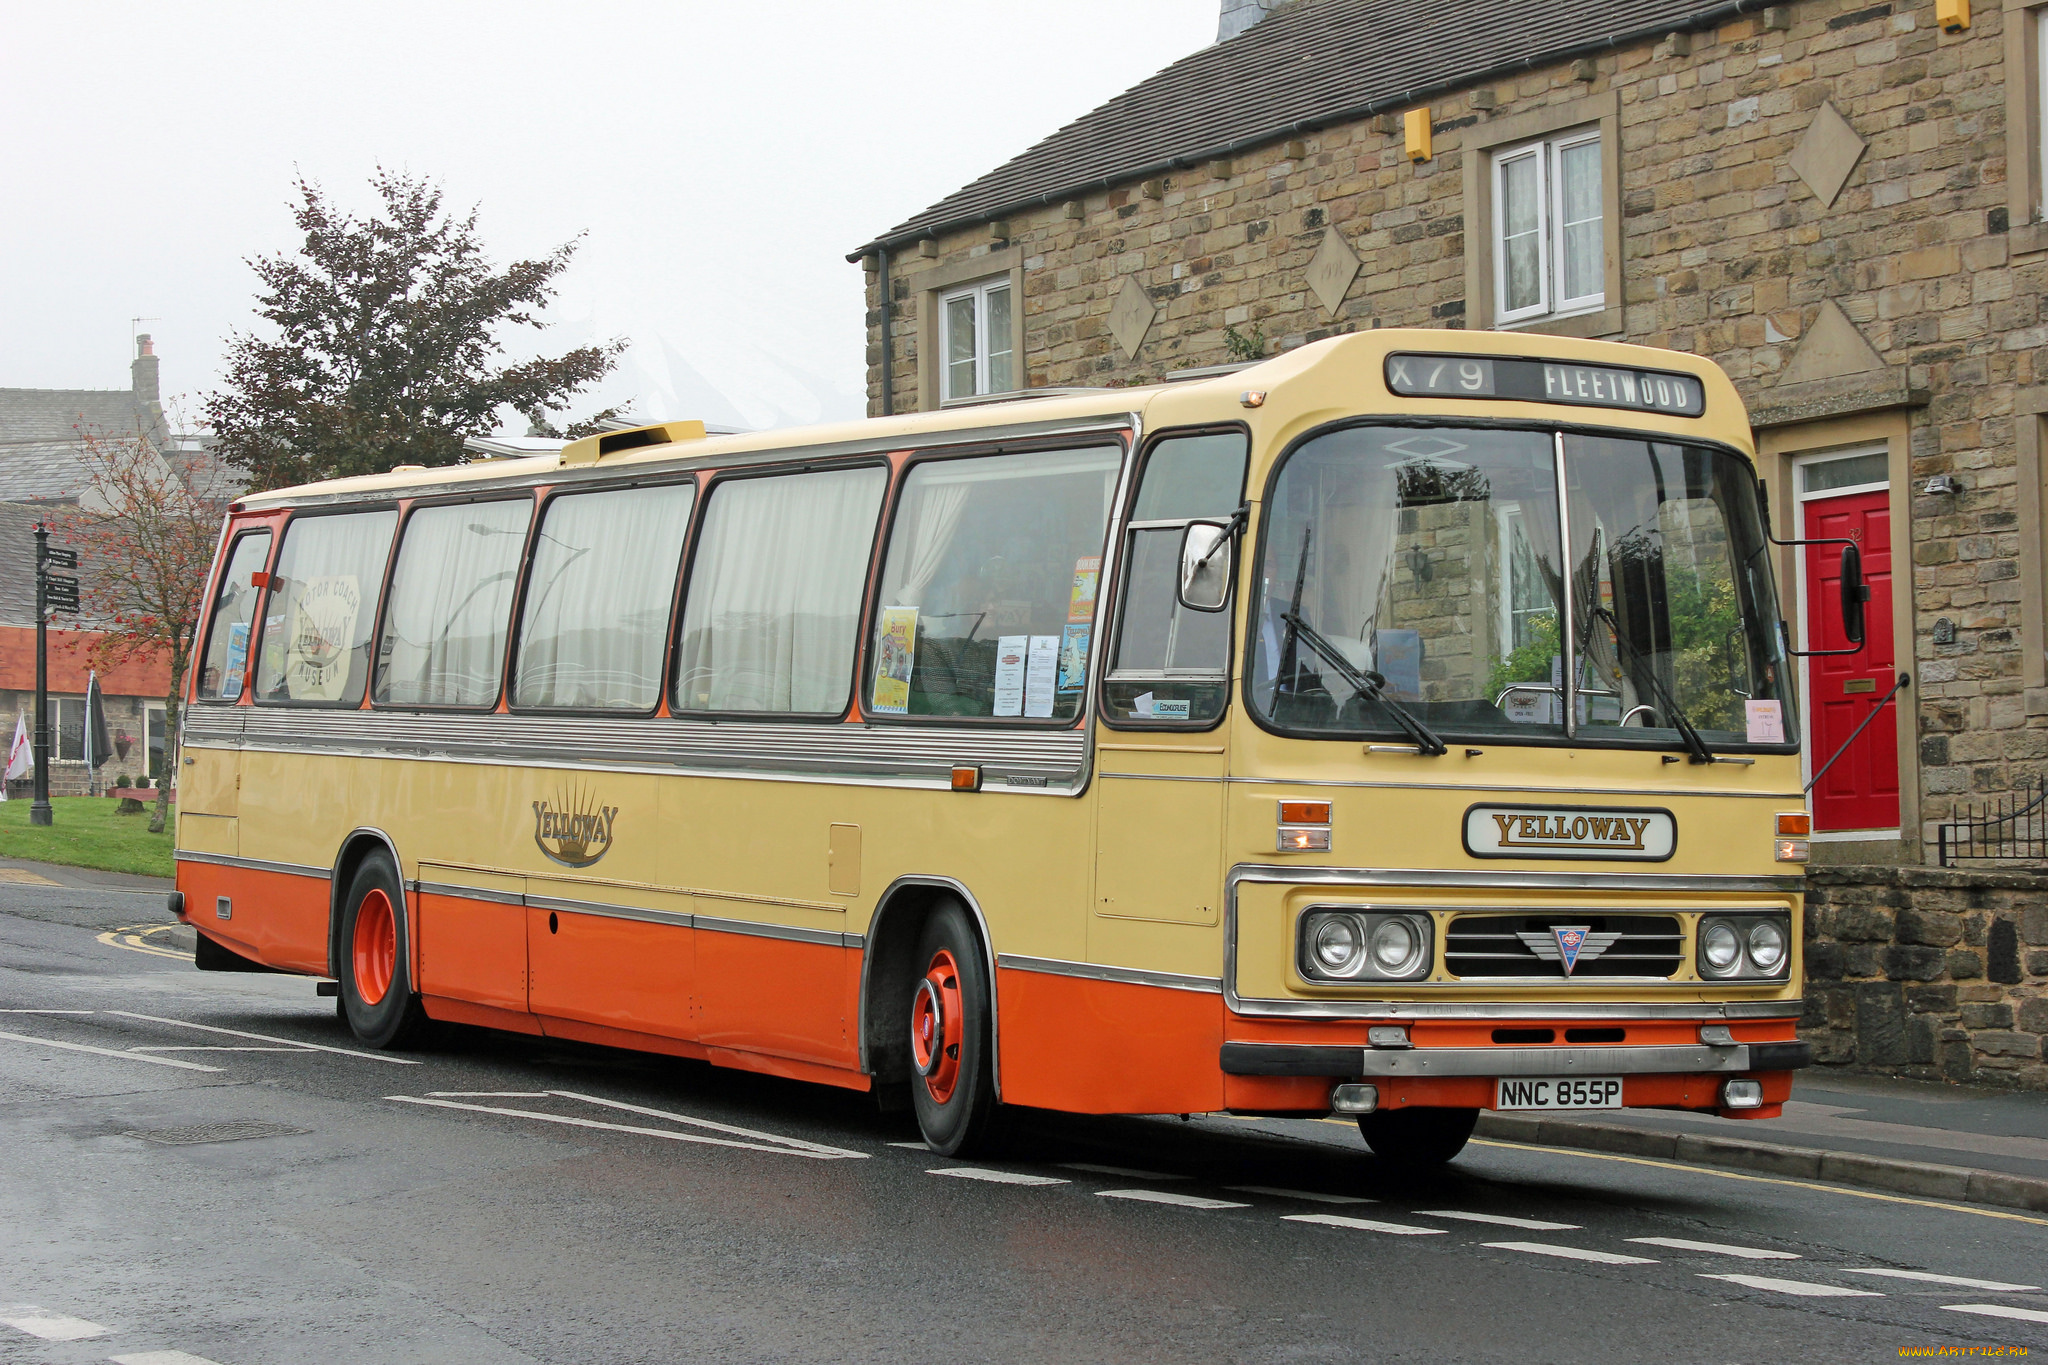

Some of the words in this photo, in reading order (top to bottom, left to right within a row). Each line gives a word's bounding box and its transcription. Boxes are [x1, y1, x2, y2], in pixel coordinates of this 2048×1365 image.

[1544, 366, 1688, 409] FLEETWOOD
[333, 580, 358, 615] COACH
[890, 622, 907, 636] Bury
[298, 660, 339, 686] MUSEUM
[532, 801, 619, 845] YELLOWAY
[1492, 814, 1651, 851] YELLOWAY
[1563, 934, 1580, 943] AEC
[1501, 1082, 1550, 1106] NNC
[1556, 1081, 1620, 1105] 855P
